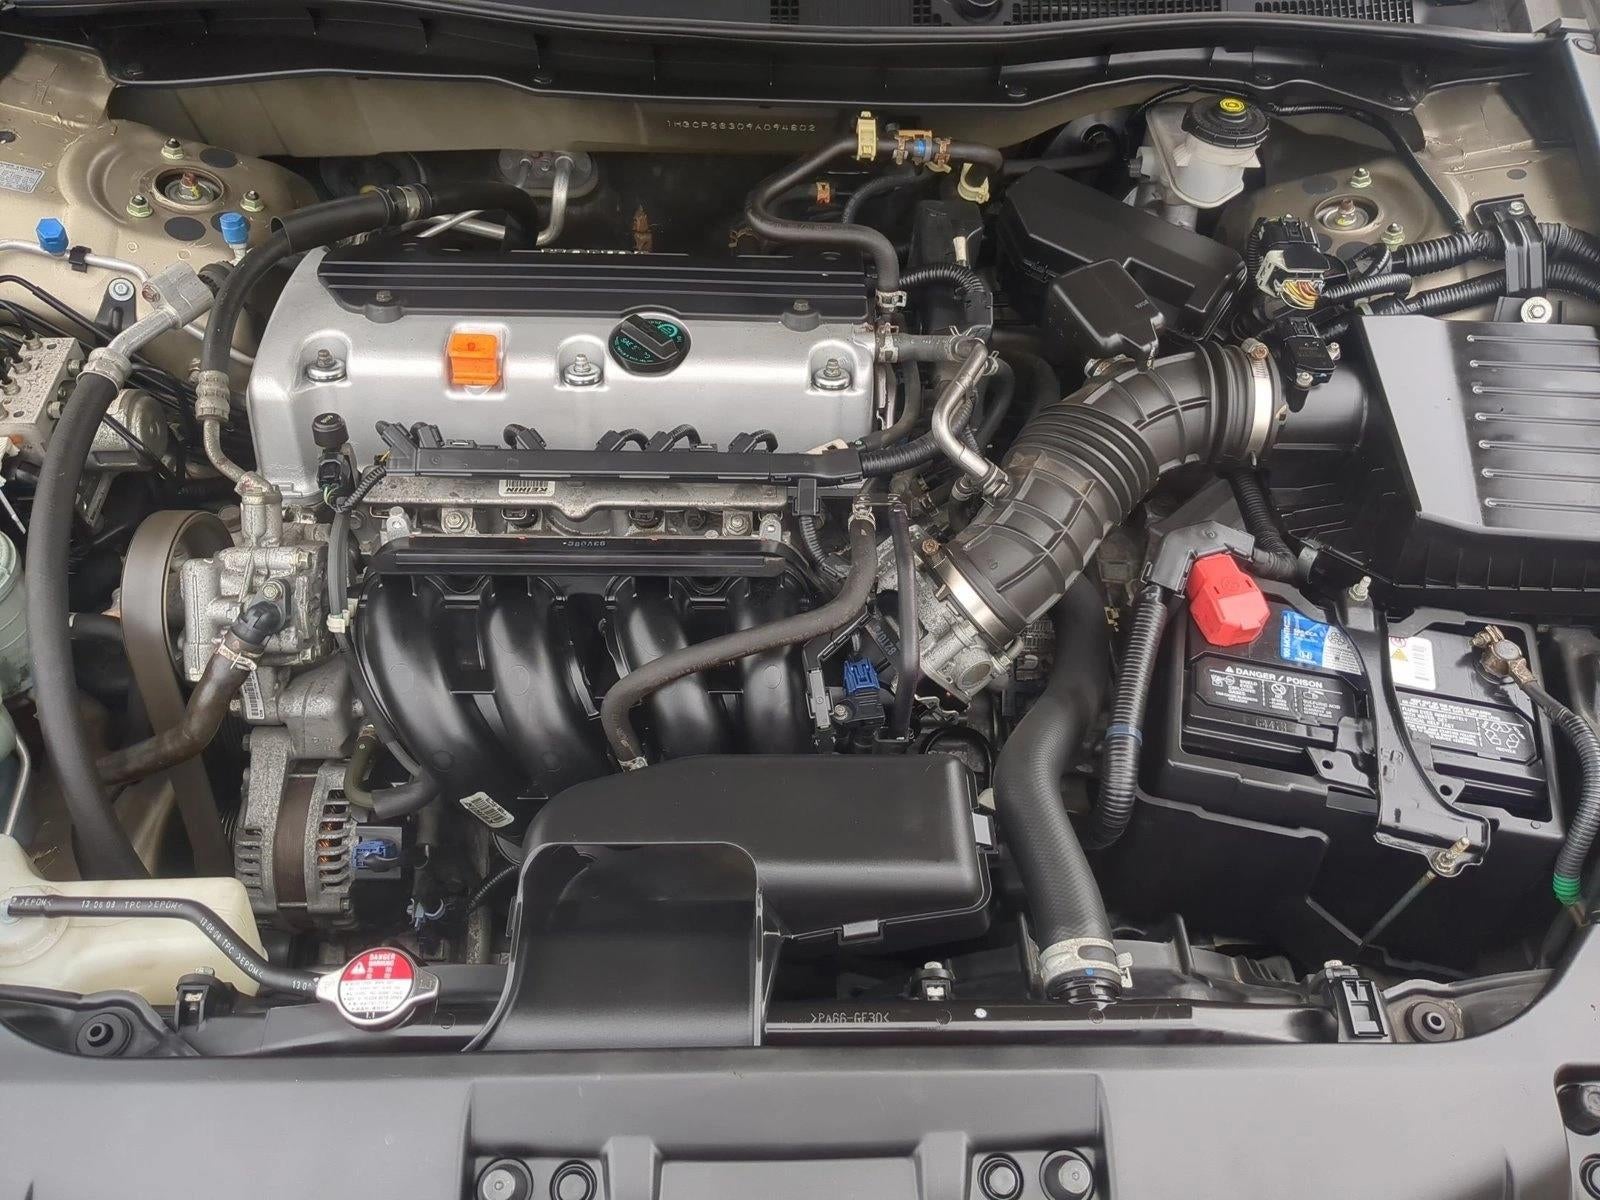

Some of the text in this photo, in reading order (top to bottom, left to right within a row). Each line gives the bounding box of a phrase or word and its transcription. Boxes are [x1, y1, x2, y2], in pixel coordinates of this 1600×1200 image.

[1235, 668, 1276, 681] DANGER
[1286, 676, 1323, 689] POISON
[124, 901, 142, 909] TPC
[221, 939, 235, 955] TPC
